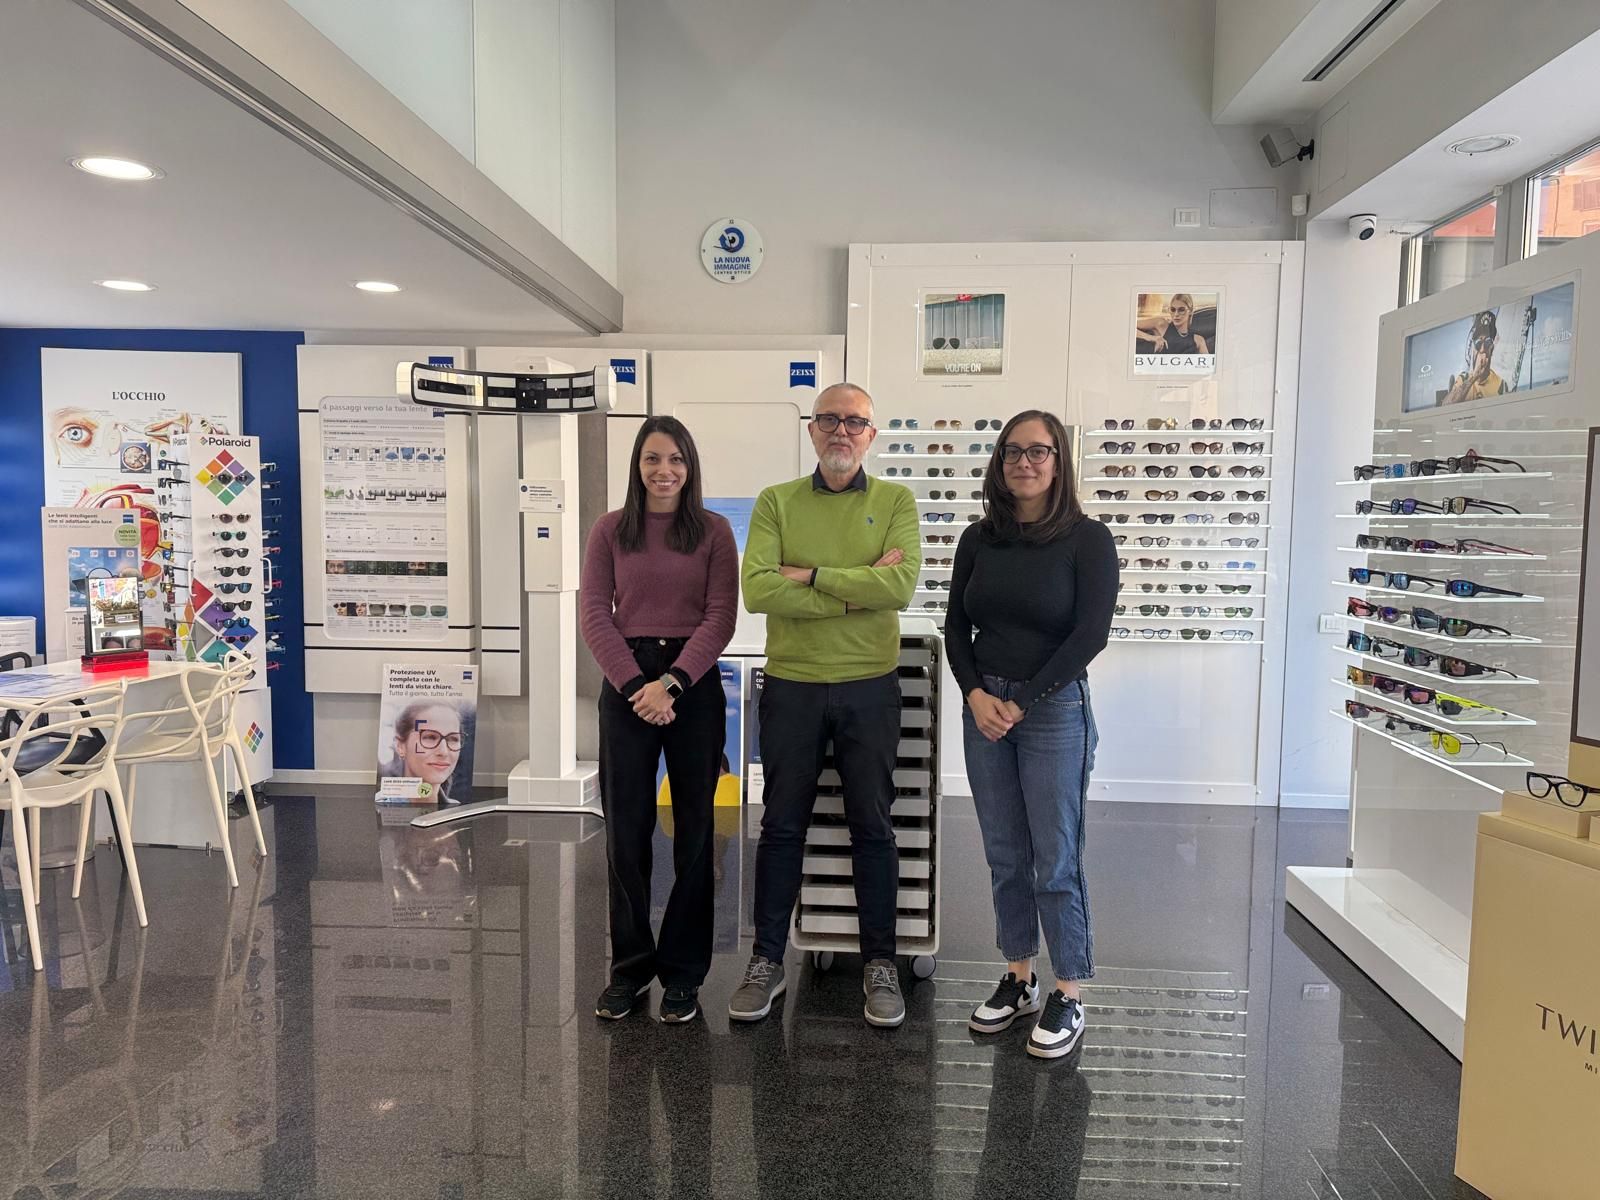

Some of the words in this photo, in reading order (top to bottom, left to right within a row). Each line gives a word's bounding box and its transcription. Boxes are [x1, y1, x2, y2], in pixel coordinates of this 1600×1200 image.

[1135, 357, 1215, 366] BVLGARI
[970, 363, 982, 372] ON
[112, 391, 166, 401] L'OCCHIO
[208, 436, 251, 448] Polaroid
[1536, 1003, 1596, 1055] TWI
